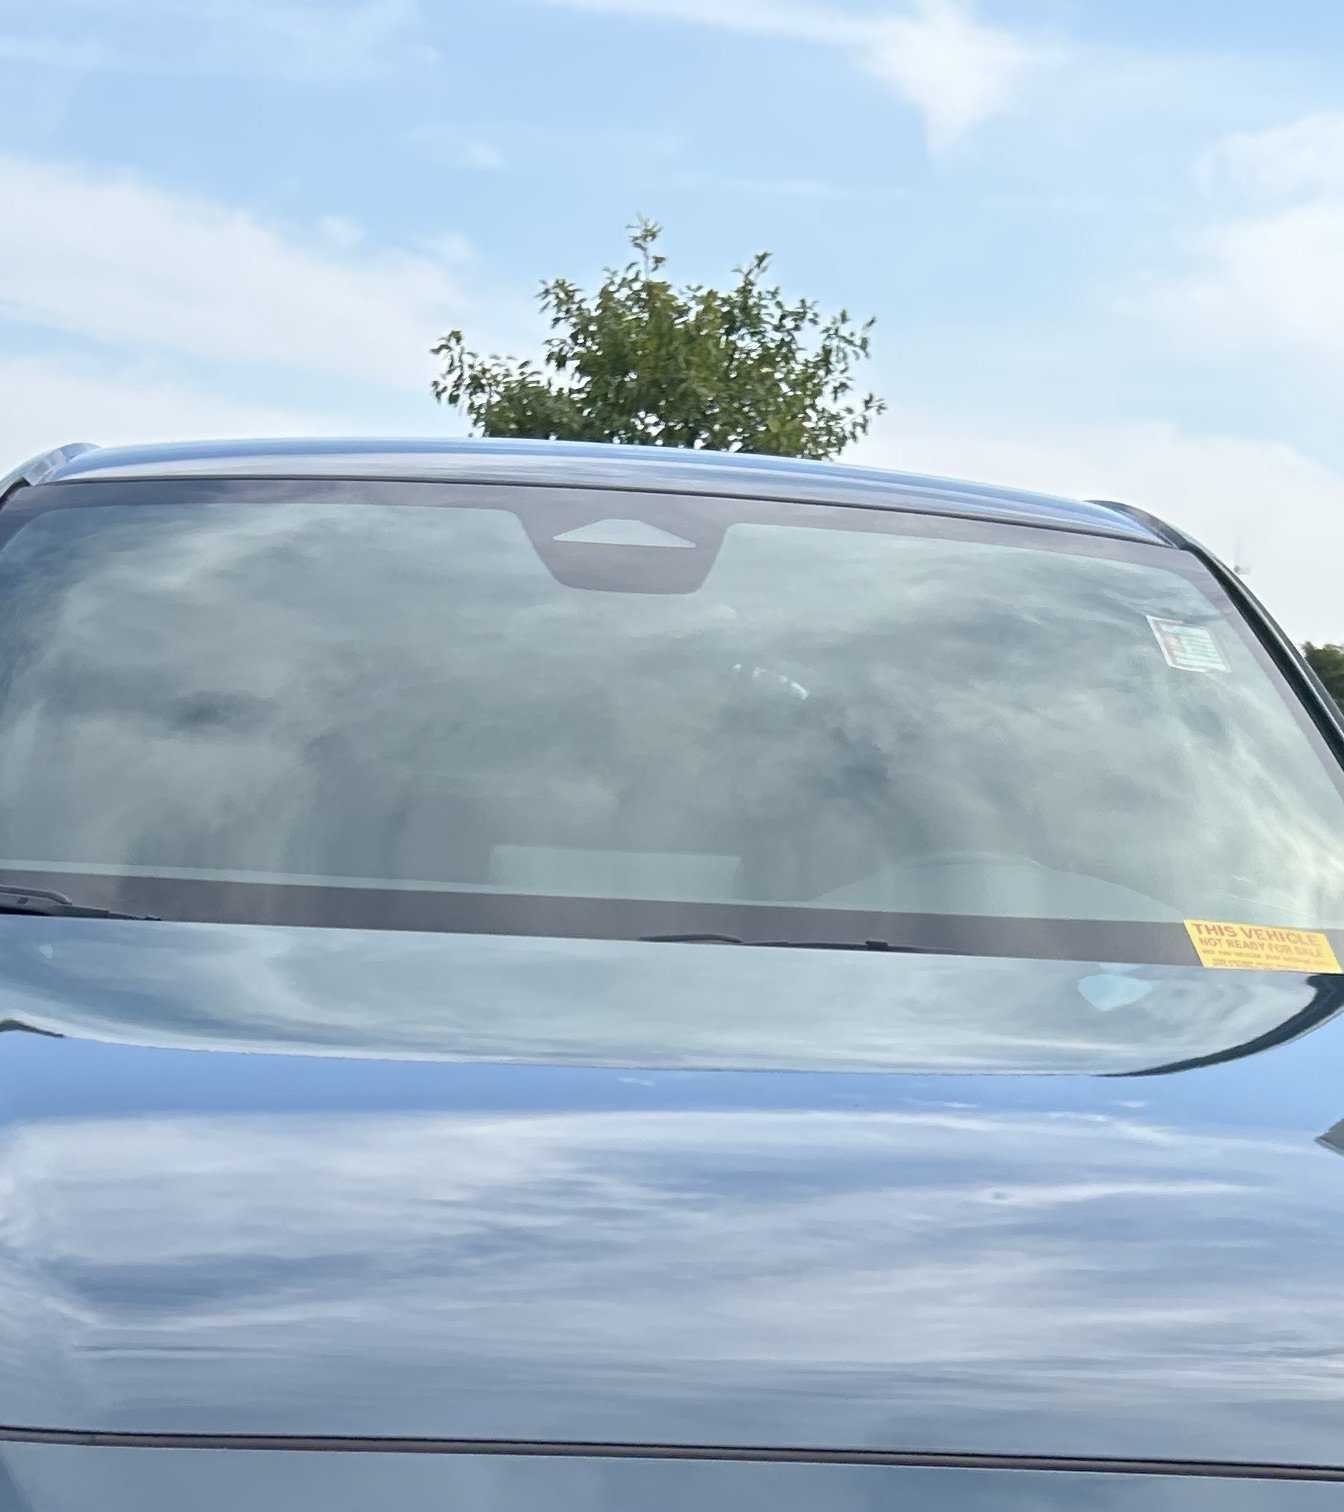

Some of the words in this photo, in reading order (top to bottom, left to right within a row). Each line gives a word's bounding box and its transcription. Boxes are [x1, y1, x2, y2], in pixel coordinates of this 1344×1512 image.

[1191, 922, 1238, 938] THIS
[1239, 926, 1321, 946] VEHICLE
[1198, 937, 1223, 949] NOT
[1225, 939, 1265, 952] READY
